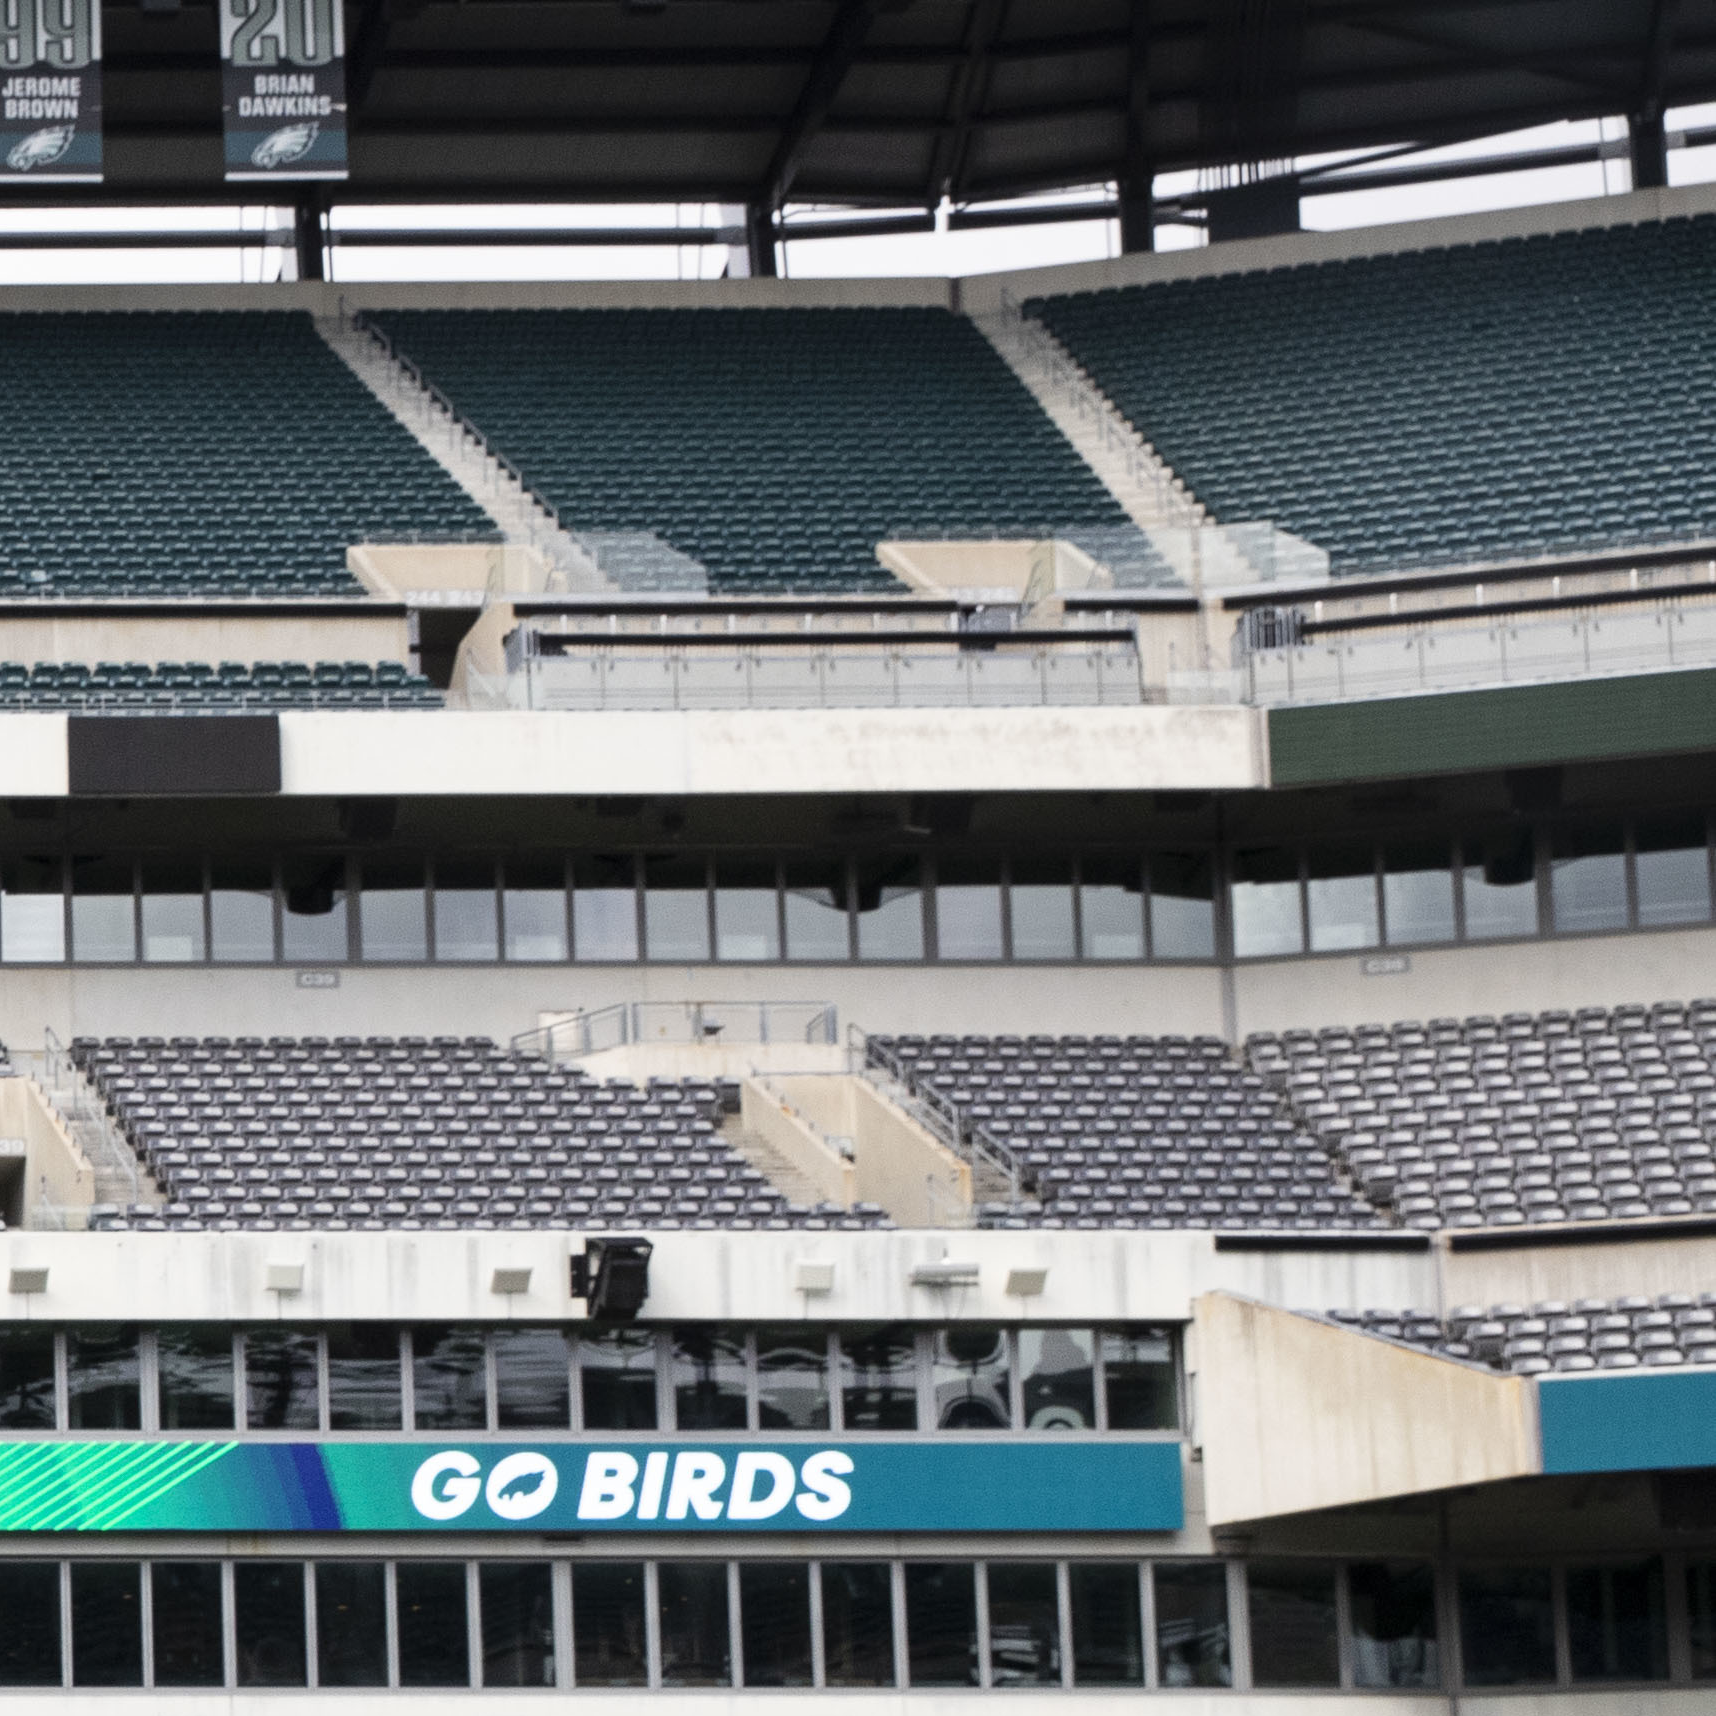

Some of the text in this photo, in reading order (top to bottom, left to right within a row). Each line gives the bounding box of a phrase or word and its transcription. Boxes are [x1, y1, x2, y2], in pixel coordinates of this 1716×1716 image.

[1, 77, 81, 97] JEROME
[254, 74, 315, 94] BRIAN
[5, 99, 79, 119] BROWN
[238, 96, 332, 117] DAWKINS
[411, 1450, 854, 1521] GO BIRDS
